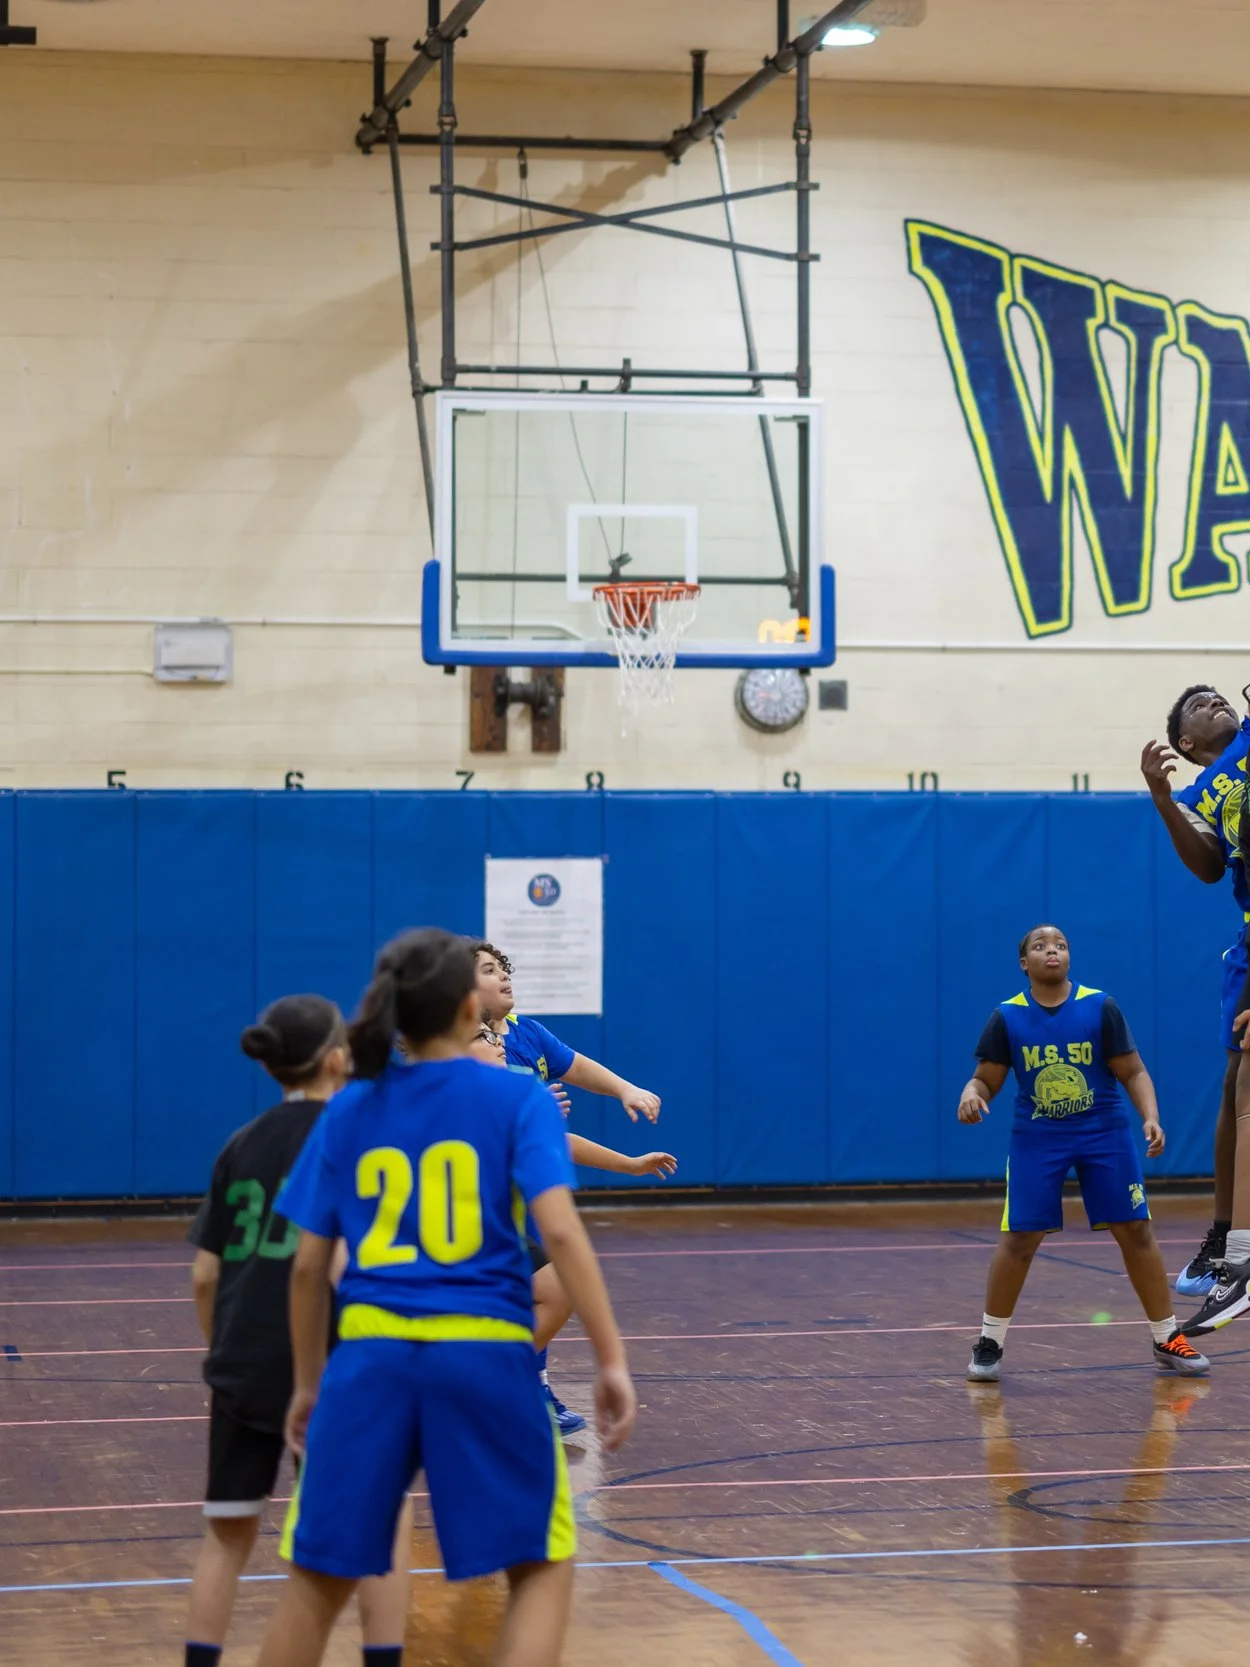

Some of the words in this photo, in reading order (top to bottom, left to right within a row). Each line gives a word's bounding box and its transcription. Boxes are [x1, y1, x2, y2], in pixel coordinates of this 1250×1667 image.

[107, 770, 127, 790] 5
[455, 770, 475, 791] 7
[1022, 1044, 1064, 1072] M.S.
[1067, 1041, 1093, 1066] 50
[1037, 1091, 1094, 1117] WARRIORS
[355, 1139, 484, 1270] 20
